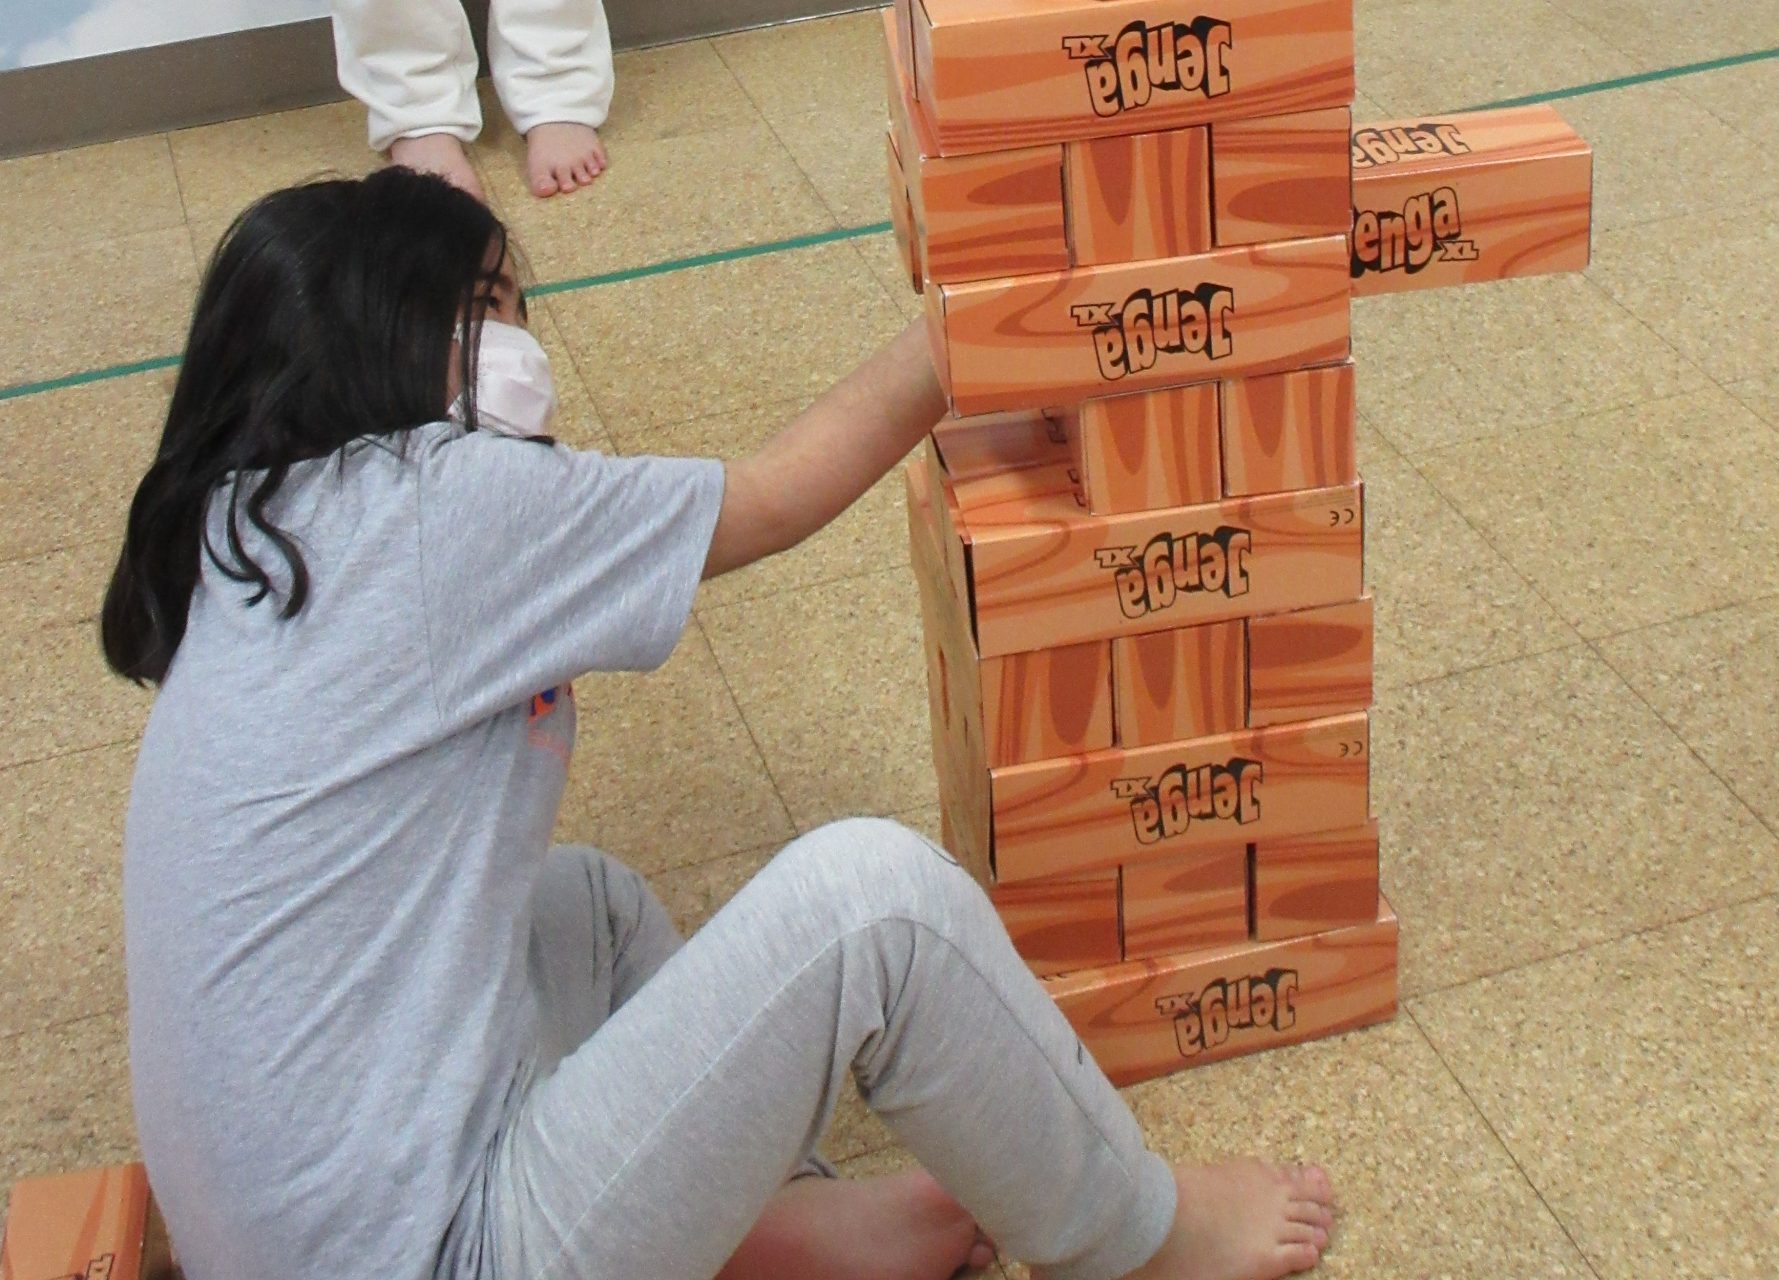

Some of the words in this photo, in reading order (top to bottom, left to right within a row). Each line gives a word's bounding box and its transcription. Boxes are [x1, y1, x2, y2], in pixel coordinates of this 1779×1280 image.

[1061, 34, 1113, 60] XL
[1084, 15, 1233, 118] Jenga
[1351, 186, 1462, 279] enga
[1437, 239, 1480, 263] XL
[1070, 302, 1119, 327] XL
[1092, 281, 1235, 382] Jenga
[1094, 545, 1138, 569] XL
[1113, 524, 1252, 620] Jenga
[1110, 776, 1153, 799] XL
[1129, 756, 1264, 846] Jenga
[1154, 991, 1196, 1016] XL
[1173, 967, 1299, 1058] Jenga
